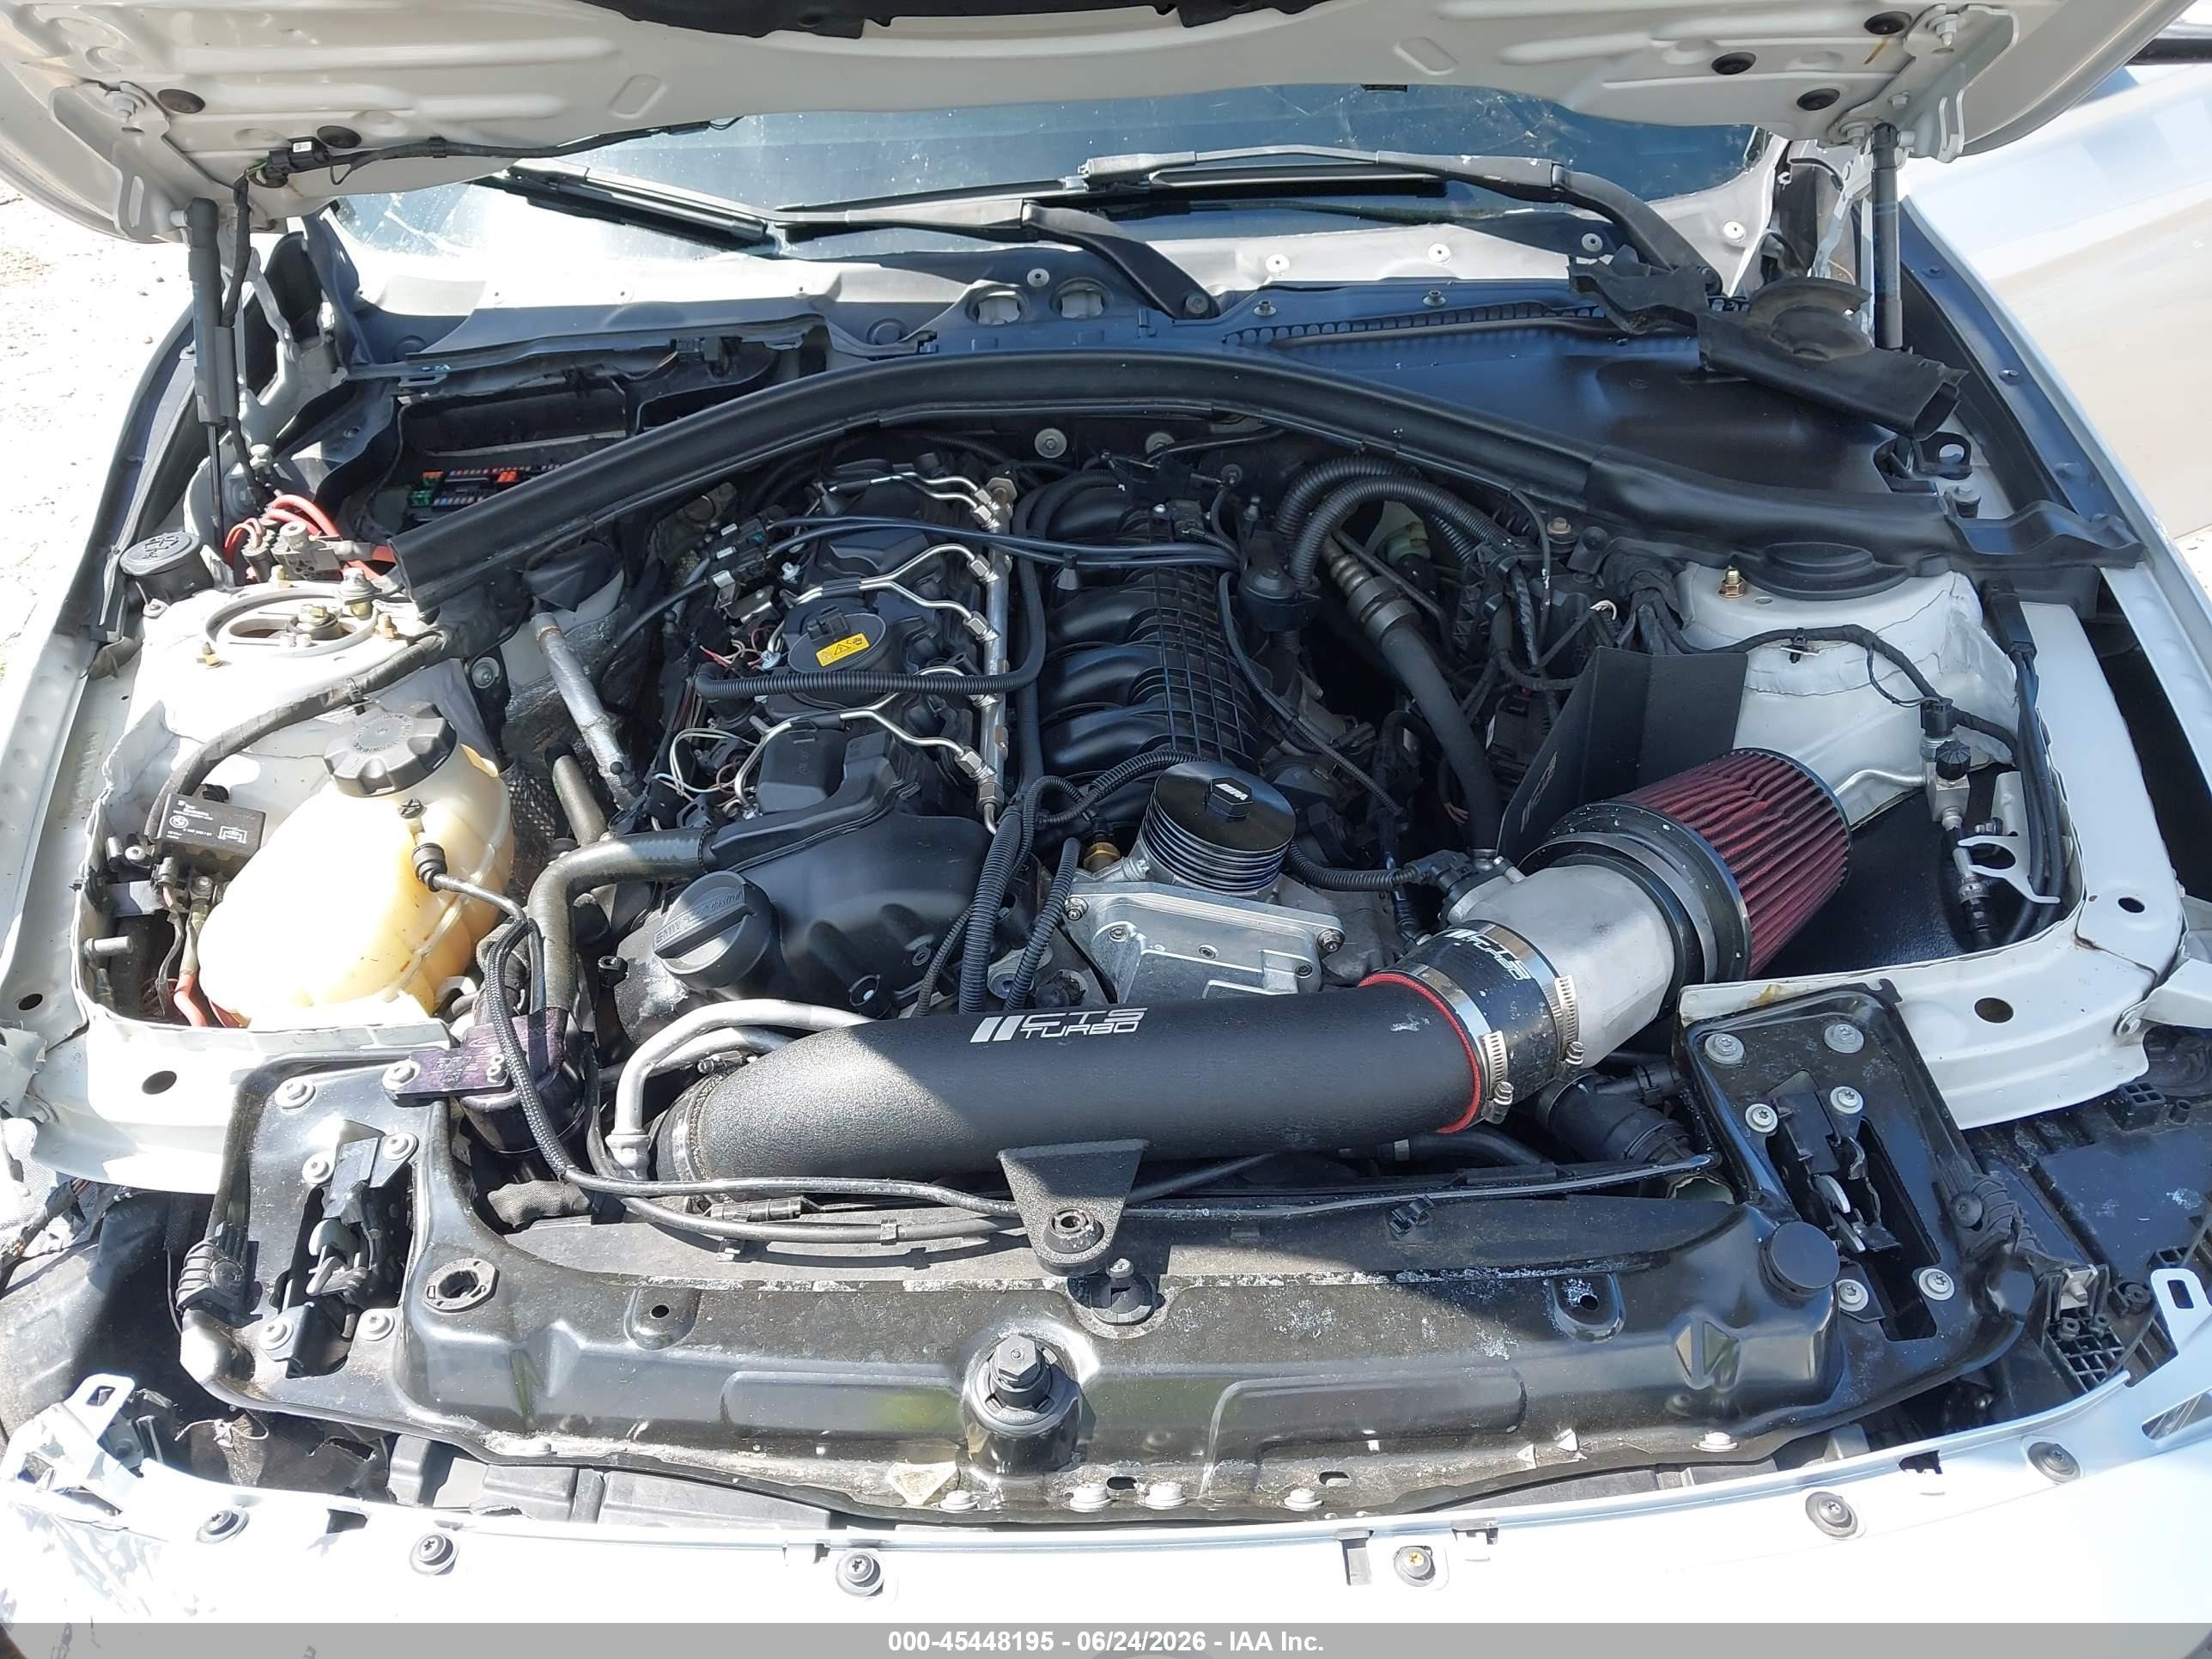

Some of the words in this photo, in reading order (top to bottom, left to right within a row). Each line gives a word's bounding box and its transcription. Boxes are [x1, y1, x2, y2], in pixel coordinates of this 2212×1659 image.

[1462, 936, 1524, 980] TURBO
[1471, 933, 1532, 980] CTS
[1020, 1021, 1139, 1039] TURBO
[1023, 1007, 1149, 1028] CTS
